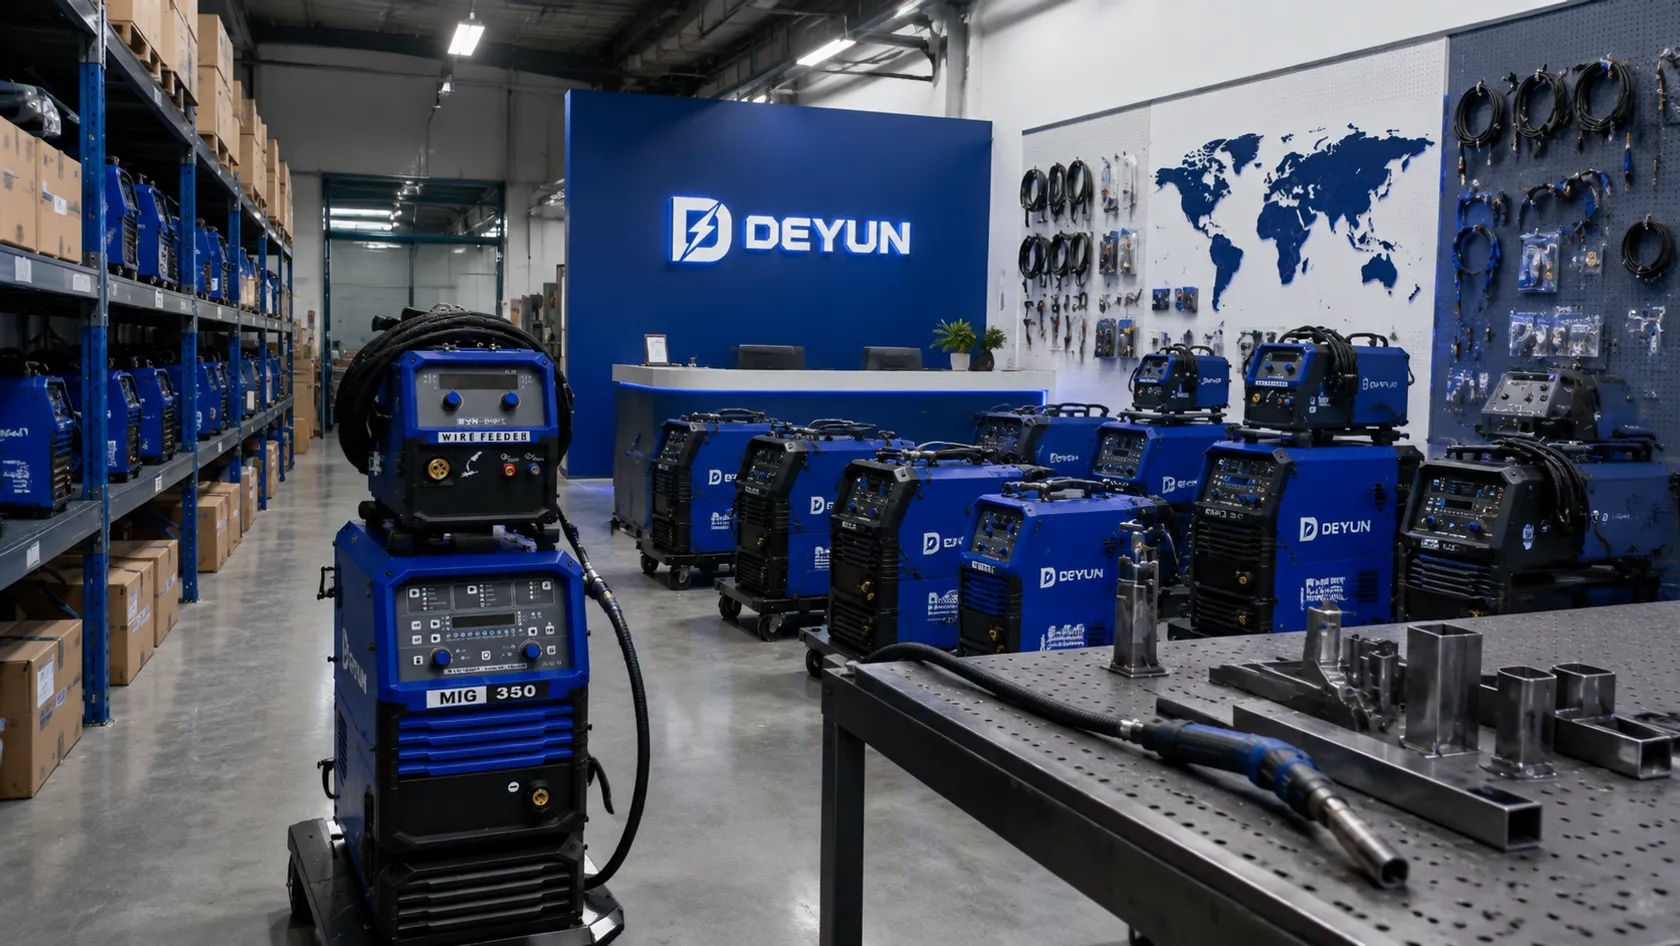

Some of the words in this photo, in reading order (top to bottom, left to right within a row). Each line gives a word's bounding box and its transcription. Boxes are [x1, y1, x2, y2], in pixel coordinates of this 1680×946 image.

[746, 215, 910, 254] DEYUN
[442, 432, 475, 442] WIRE
[1322, 520, 1371, 535] DEYUN
[439, 690, 478, 705] MIG
[496, 685, 536, 699] 350
